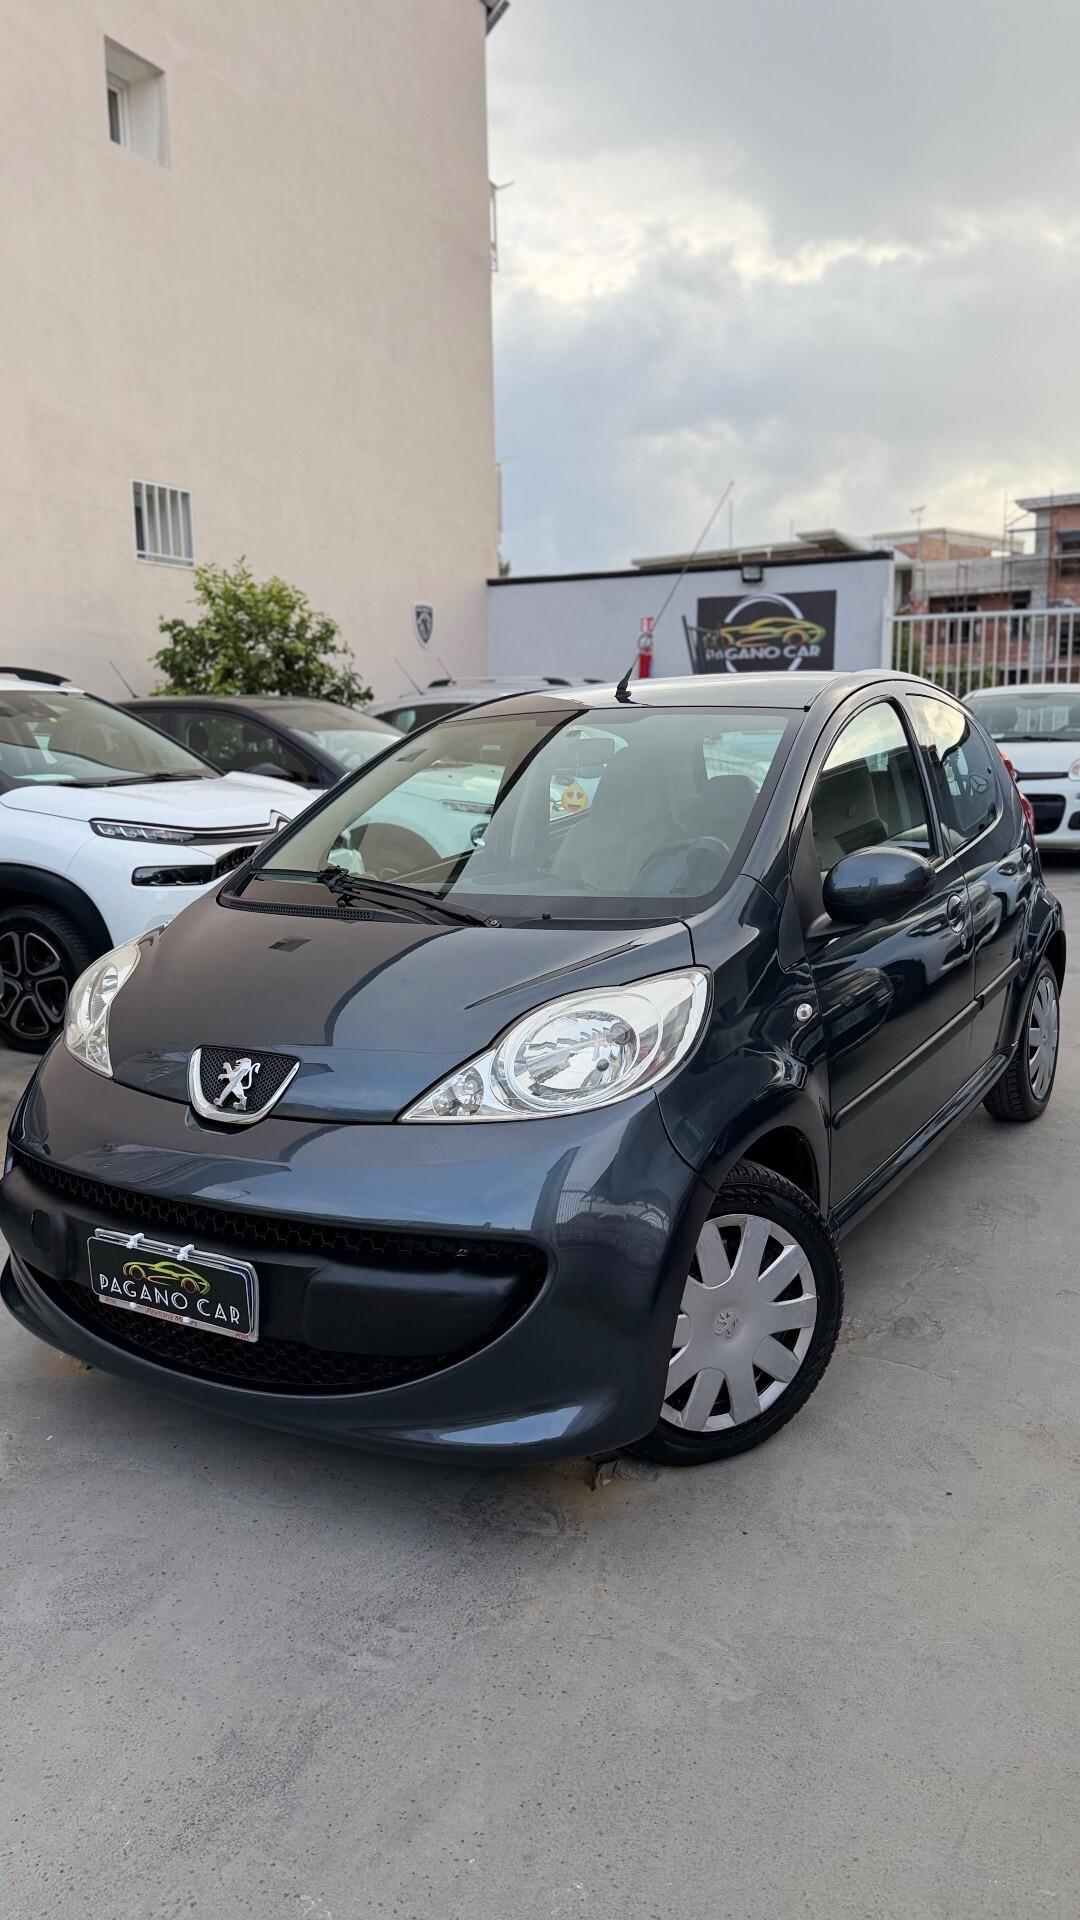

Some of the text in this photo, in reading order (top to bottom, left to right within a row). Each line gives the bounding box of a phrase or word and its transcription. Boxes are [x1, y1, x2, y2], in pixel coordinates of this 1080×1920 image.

[783, 644, 821, 658] CAR
[99, 1273, 188, 1310] PAGANO
[196, 1298, 240, 1325] CAR
